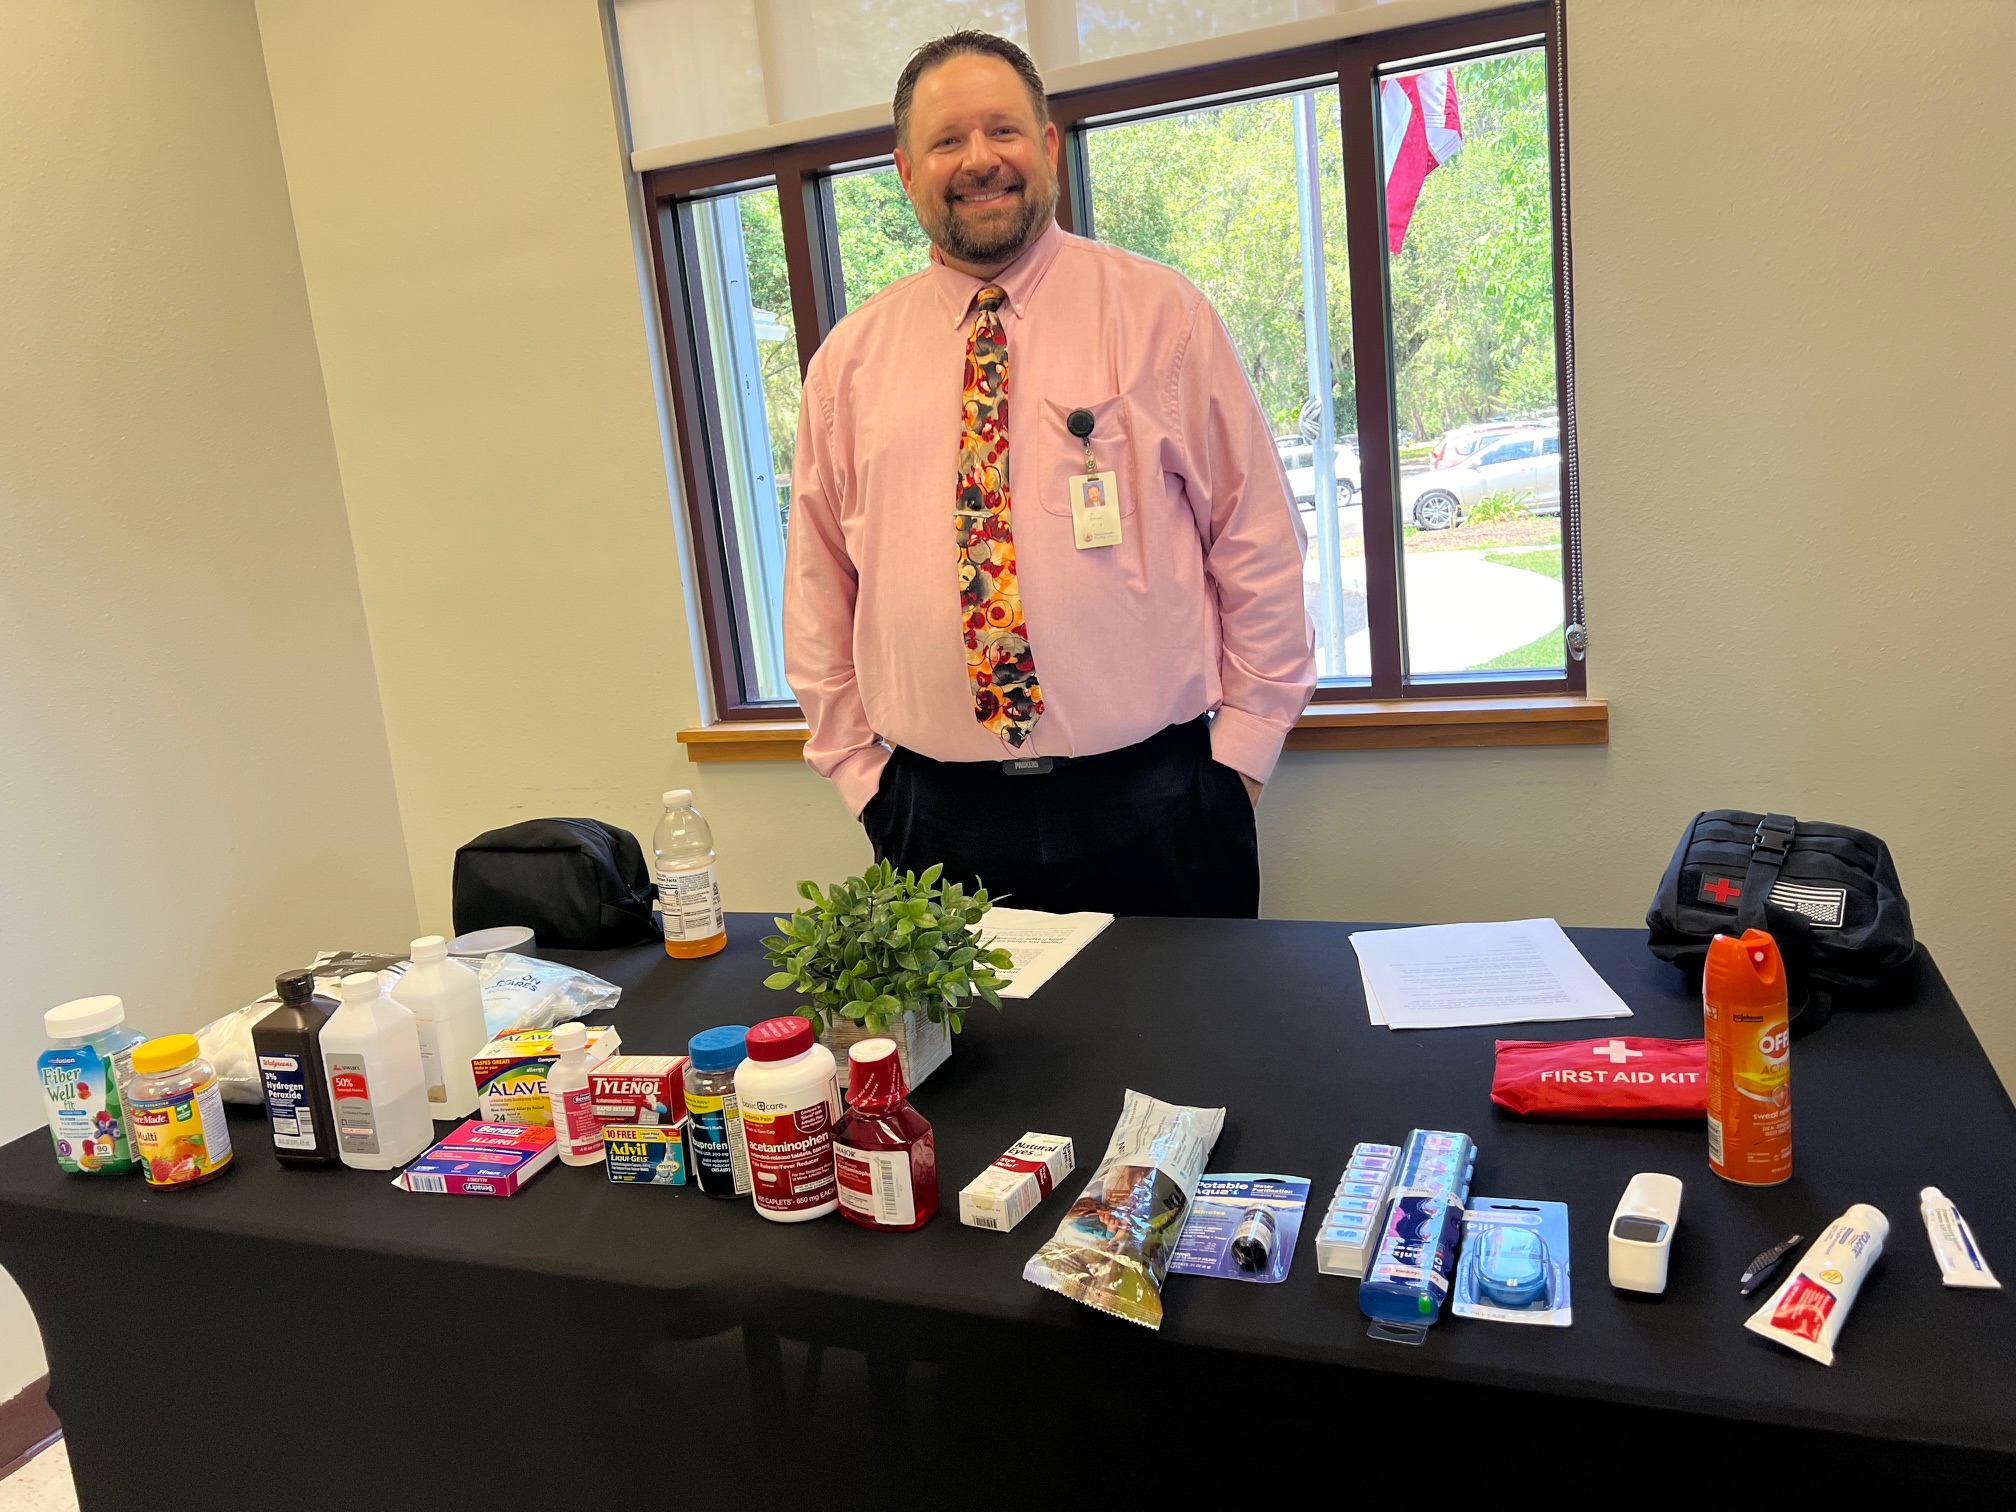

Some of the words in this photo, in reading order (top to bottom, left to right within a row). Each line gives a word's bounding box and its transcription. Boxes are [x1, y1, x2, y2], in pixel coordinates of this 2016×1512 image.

[1014, 761, 1039, 769] PACKERS
[262, 1060, 293, 1068] Walgreens
[42, 1068, 81, 1086] Fiber
[265, 1072, 278, 1080] 3%
[1541, 1070, 1609, 1083] FIRST
[1612, 1072, 1654, 1084] AID
[1660, 1072, 1700, 1084] KIT
[266, 1081, 304, 1092] Hydrogen
[336, 1078, 354, 1087] 50%
[592, 1078, 662, 1096] TYLENOL
[46, 1083, 76, 1102] Well
[268, 1090, 302, 1100] Peroxide
[64, 1099, 76, 1111] fit
[176, 1104, 188, 1112] NEW
[494, 1114, 505, 1122] 24
[1752, 1110, 1778, 1120] sweat
[606, 1130, 616, 1138] 10
[616, 1131, 637, 1140] FREE
[466, 1137, 521, 1146] ALLERGY
[749, 1132, 829, 1153] acetaminophen
[610, 1142, 647, 1156] Advil
[836, 1146, 856, 1158] MAJOR
[1008, 1148, 1034, 1156] Eyes
[1014, 1142, 1058, 1152] Natural
[751, 1152, 790, 1160] extended-release
[1066, 1142, 1074, 1169] Natural
[796, 1158, 820, 1168] Reducer
[466, 1184, 494, 1192] Benadryl
[1198, 1182, 1249, 1190] Potable
[796, 1196, 808, 1204] 650
[809, 1194, 820, 1202] mg
[820, 1187, 836, 1198] EACH
[1354, 1186, 1374, 1197] W
[1349, 1201, 1368, 1210] T
[1343, 1214, 1362, 1223] F
[1466, 1222, 1494, 1230] Pill
[1336, 1230, 1357, 1238] S
[1852, 1231, 1870, 1259] equate
